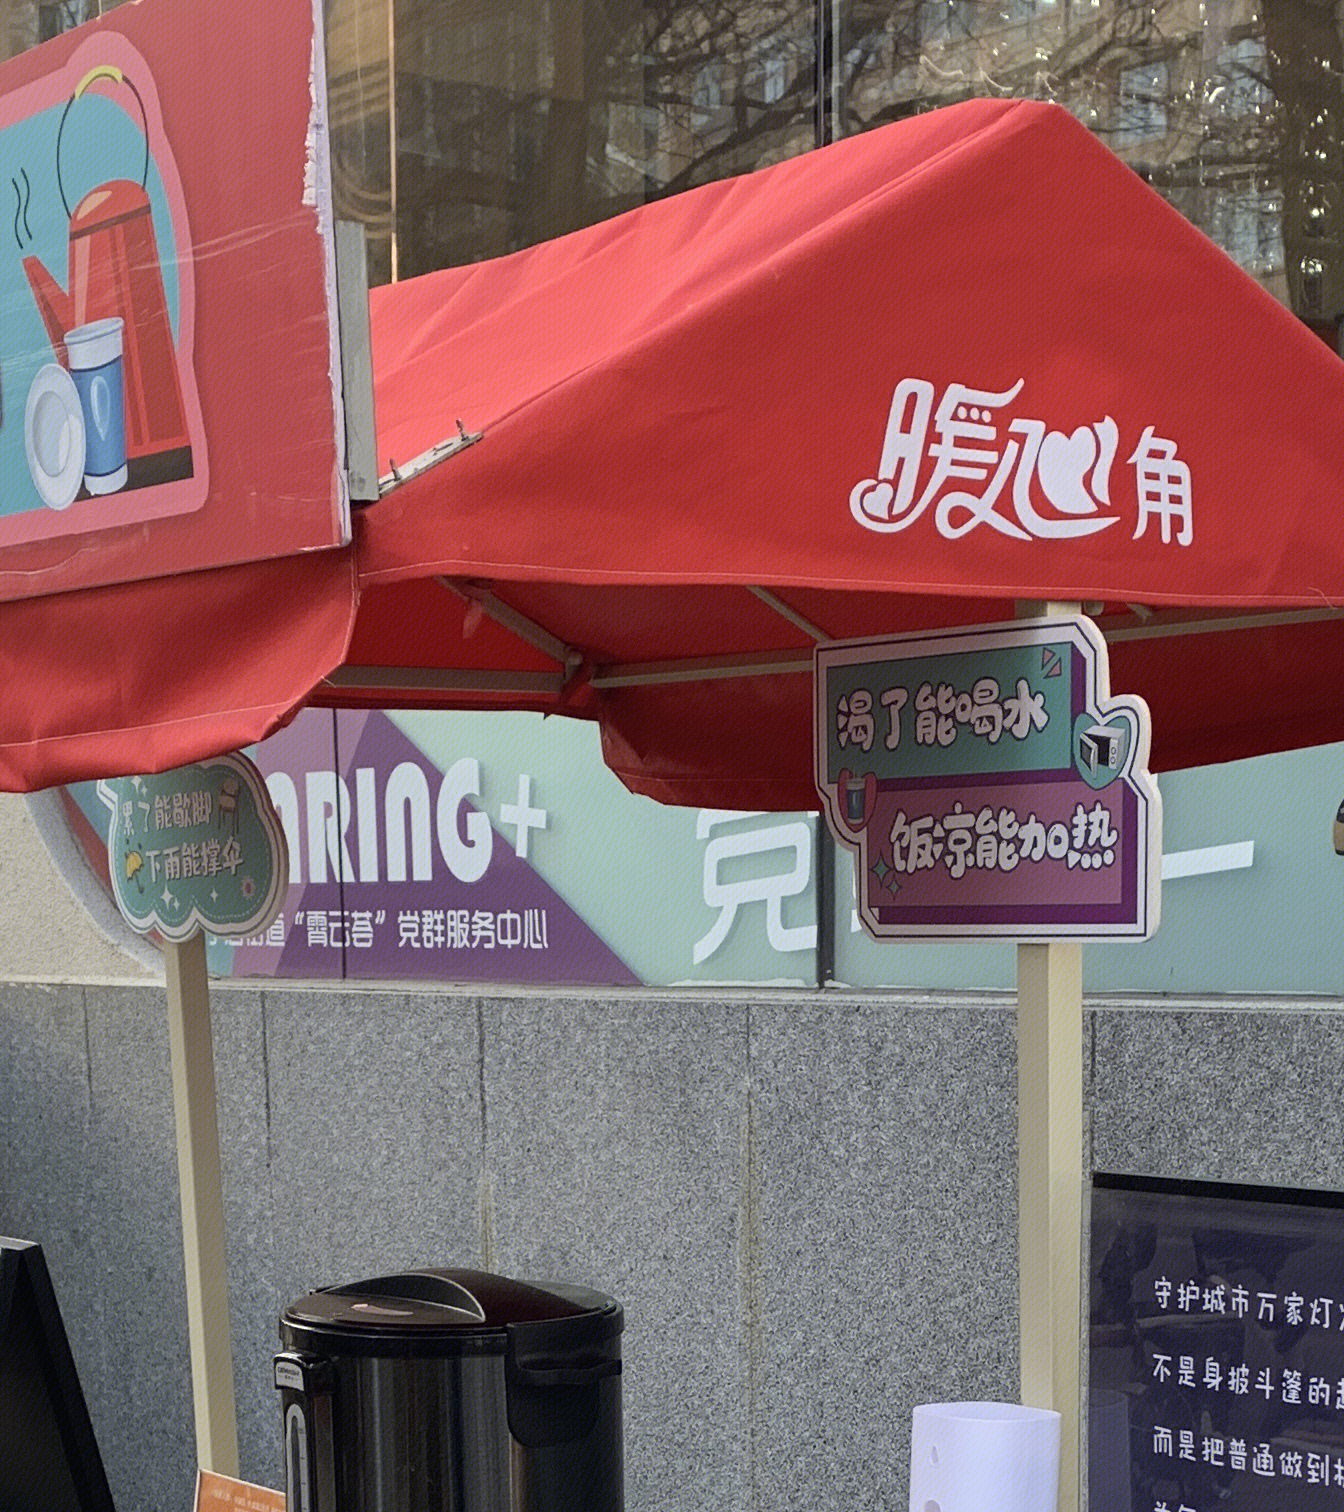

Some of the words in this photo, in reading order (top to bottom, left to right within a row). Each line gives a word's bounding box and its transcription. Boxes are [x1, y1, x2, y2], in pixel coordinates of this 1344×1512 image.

[849, 377, 1194, 546] 暖心角
[836, 677, 1049, 753] 渴了能喝水
[120, 791, 212, 838] 累了能歇脚
[889, 802, 1118, 879] 饭凉能加热
[145, 835, 244, 883] 下雨能撑伞
